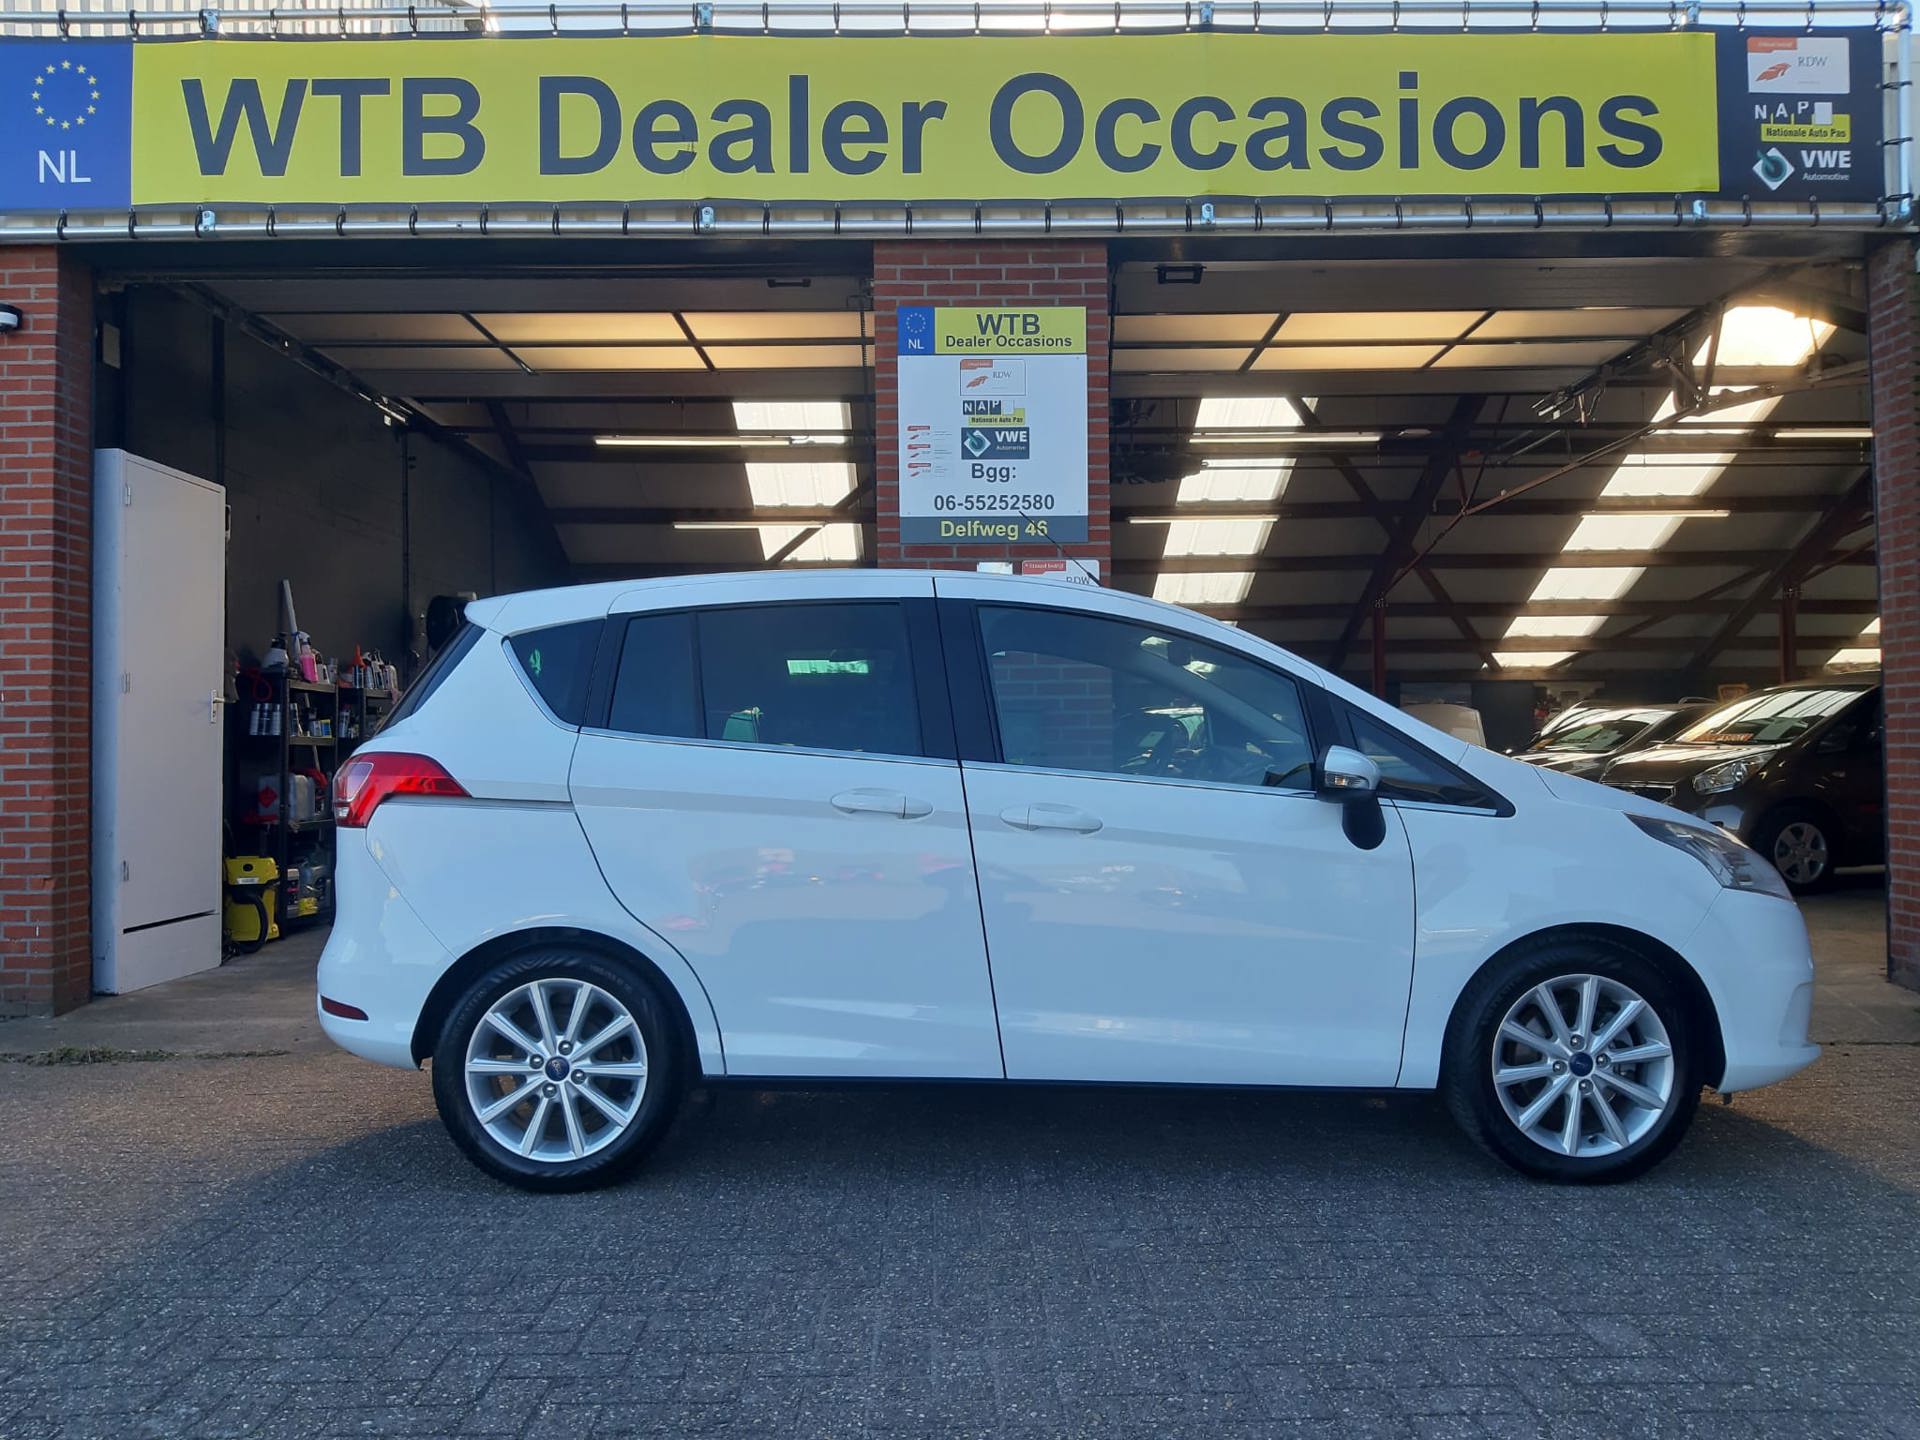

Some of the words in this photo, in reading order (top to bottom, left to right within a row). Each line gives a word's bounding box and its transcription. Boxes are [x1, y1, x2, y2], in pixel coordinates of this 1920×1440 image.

[1797, 56, 1829, 68] RDW
[180, 77, 487, 177] WTB
[538, 74, 948, 176] Dealer
[989, 70, 1664, 175] Occasions
[1766, 127, 1807, 138] Nationale
[1808, 128, 1828, 138] Auto
[1830, 129, 1846, 138] Pas
[37, 150, 92, 184] NL
[1800, 150, 1852, 169] VWE
[1802, 172, 1849, 182] Automotive
[976, 313, 1041, 335] WTB
[908, 338, 925, 350] NL
[945, 335, 992, 347] Dealer
[996, 335, 1072, 348] Occasions
[995, 431, 1028, 443] VWE
[971, 463, 1017, 483] Bgg:
[933, 494, 1055, 511] 06-55252580
[940, 519, 1019, 540] Delfweg
